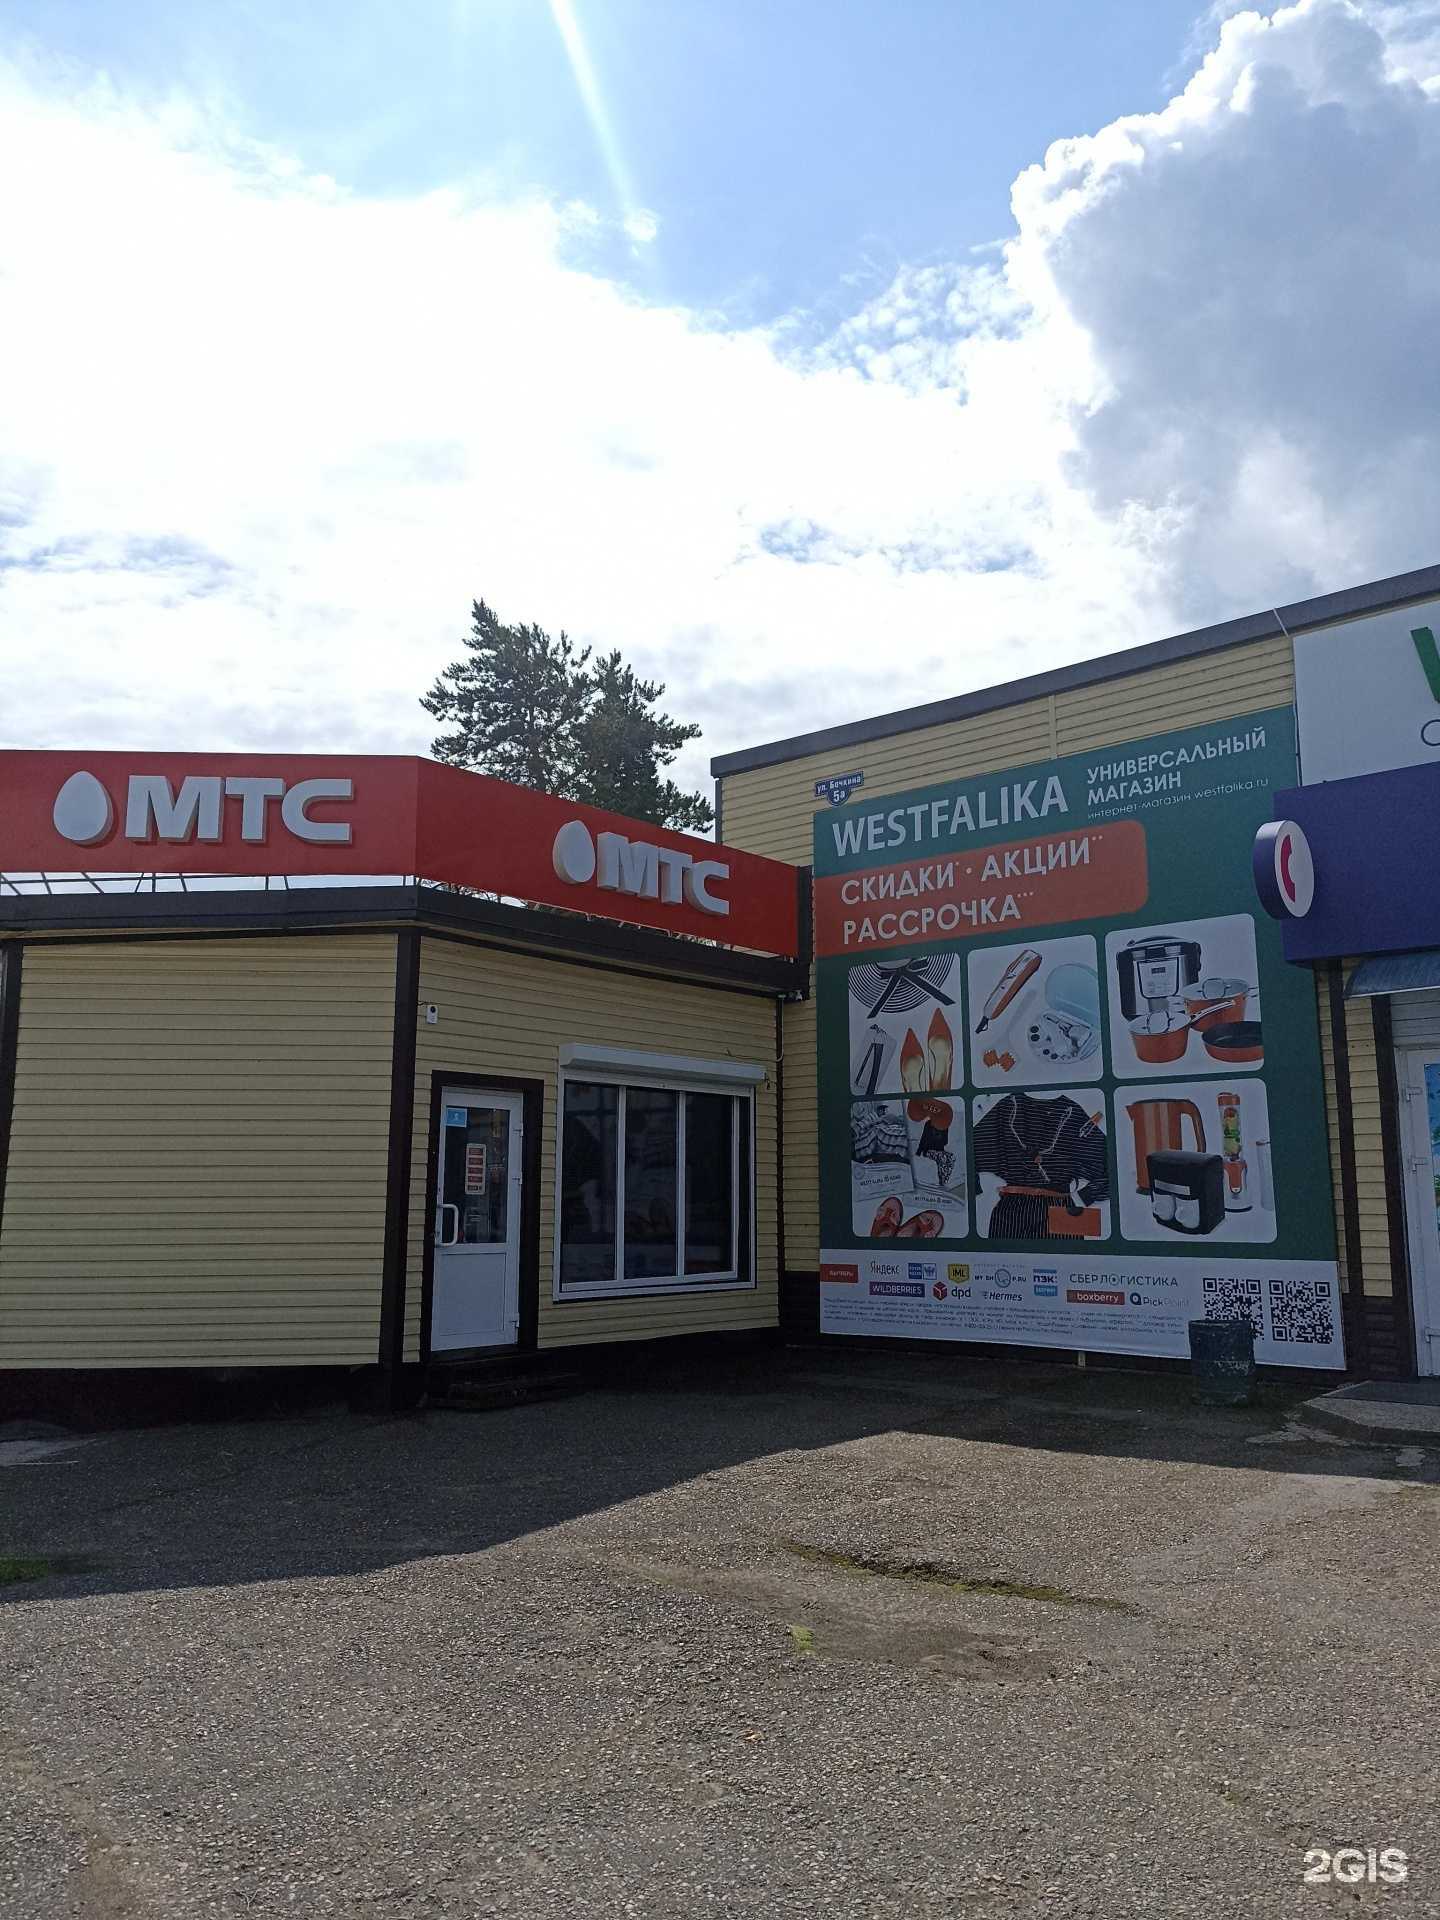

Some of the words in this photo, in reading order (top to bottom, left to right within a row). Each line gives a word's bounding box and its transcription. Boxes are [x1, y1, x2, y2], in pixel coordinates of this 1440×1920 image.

[1087, 726, 1266, 785] УНИВЕРСАЛЬНЫЙ
[1087, 771, 1182, 806] МАГАЗИН
[1087, 792, 1191, 819] интернет-магазин
[1194, 778, 1269, 799] westfalika.ru
[125, 774, 354, 844] МТС
[832, 775, 1069, 857] WESTFALIKA
[597, 831, 731, 917] МТС
[870, 1260, 900, 1275] Яндекс
[952, 1269, 967, 1277] IML
[872, 1285, 923, 1295] WILDBERRIES
[951, 1286, 972, 1299] dpd
[989, 1292, 1023, 1301] Hermes
[1076, 1292, 1119, 1303] boxberry
